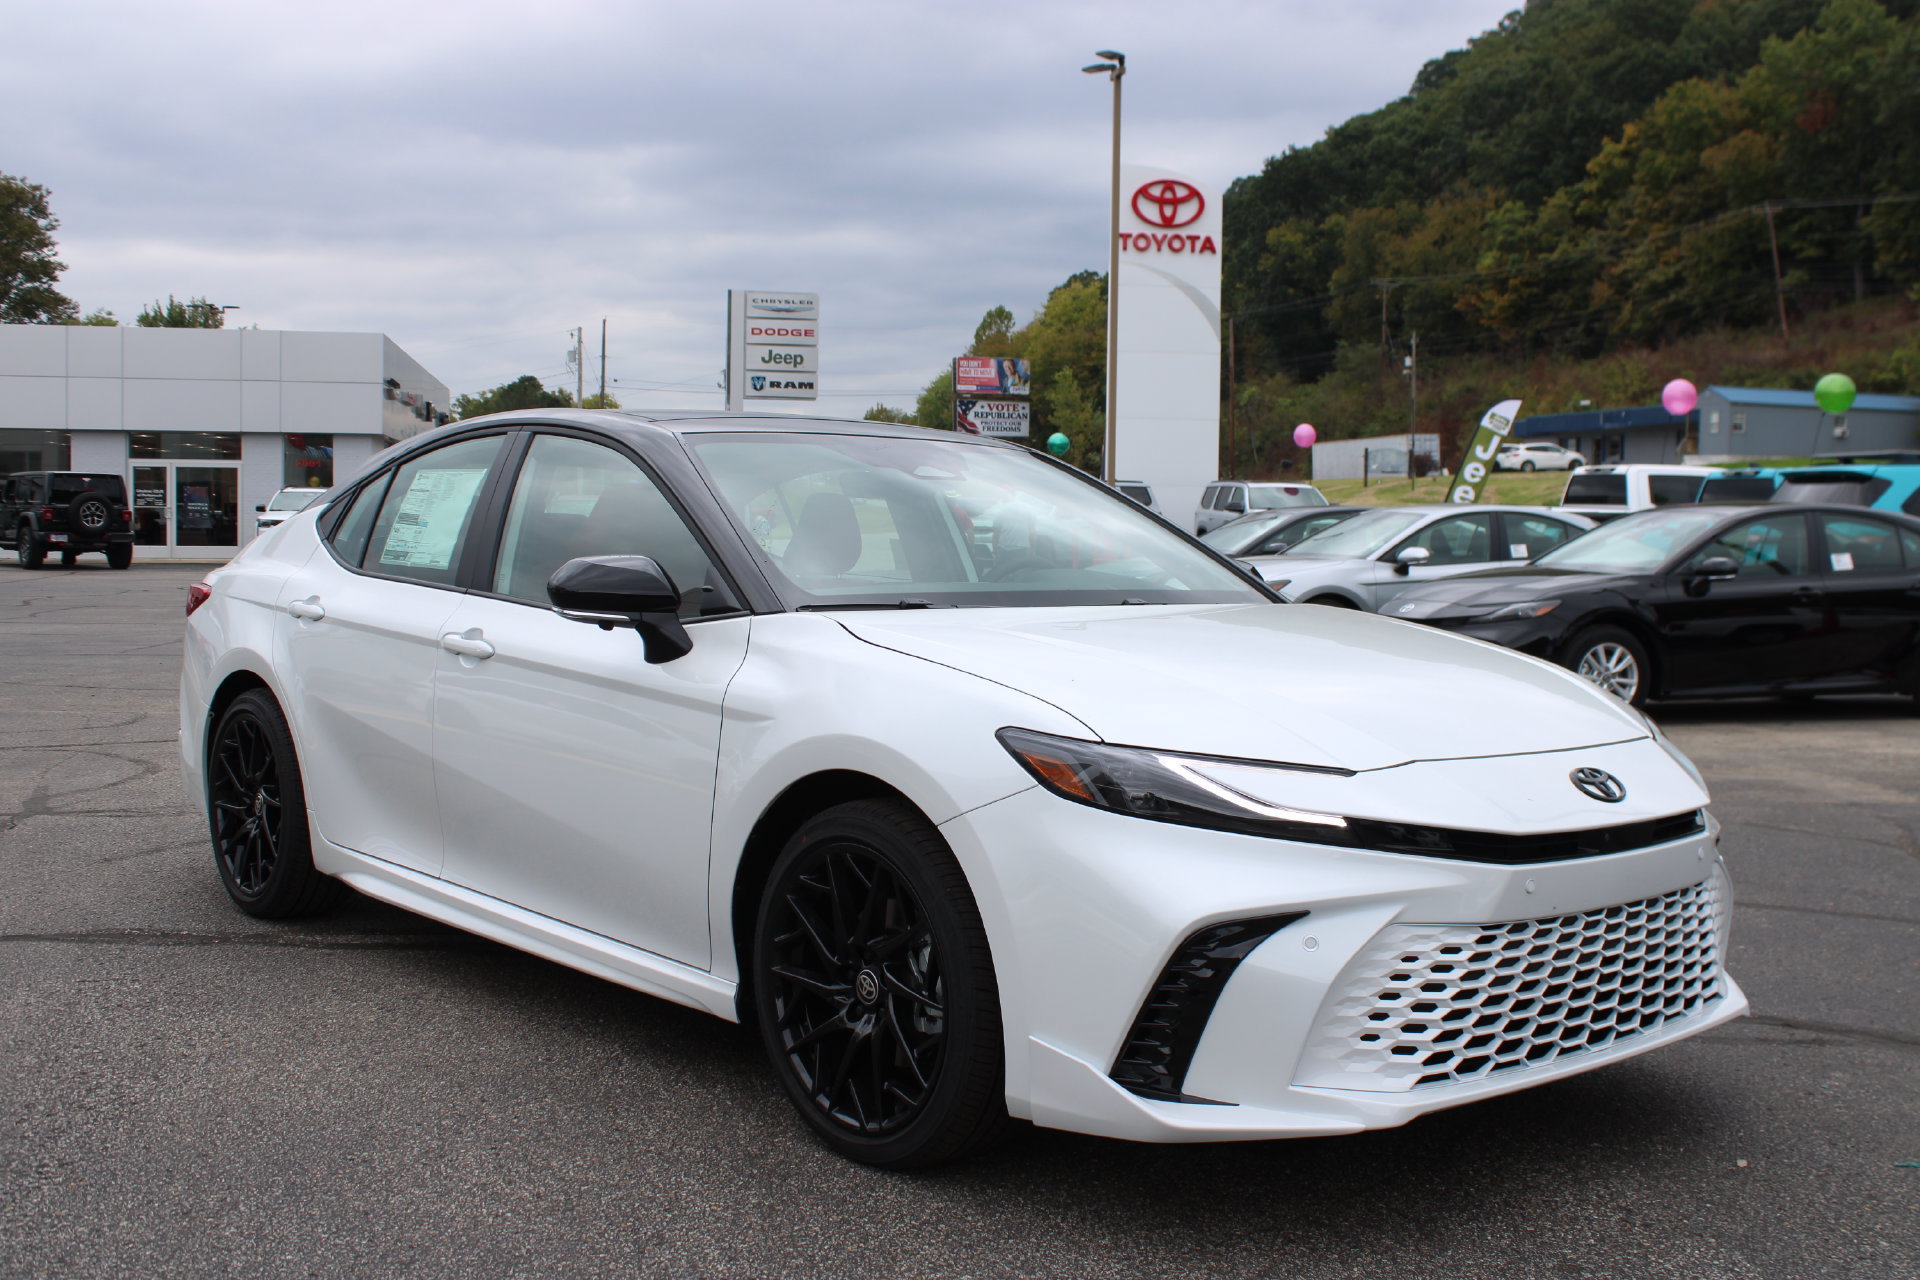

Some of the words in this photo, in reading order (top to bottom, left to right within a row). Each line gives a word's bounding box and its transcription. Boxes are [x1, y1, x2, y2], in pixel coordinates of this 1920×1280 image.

[1119, 233, 1217, 255] TOYOTA
[751, 327, 815, 337] DODGE
[761, 349, 804, 368] Jeep
[769, 380, 814, 390] RAM
[987, 403, 1020, 412] VOTE
[974, 411, 1028, 420] REPUBLICAN
[1453, 435, 1502, 504] Jee
